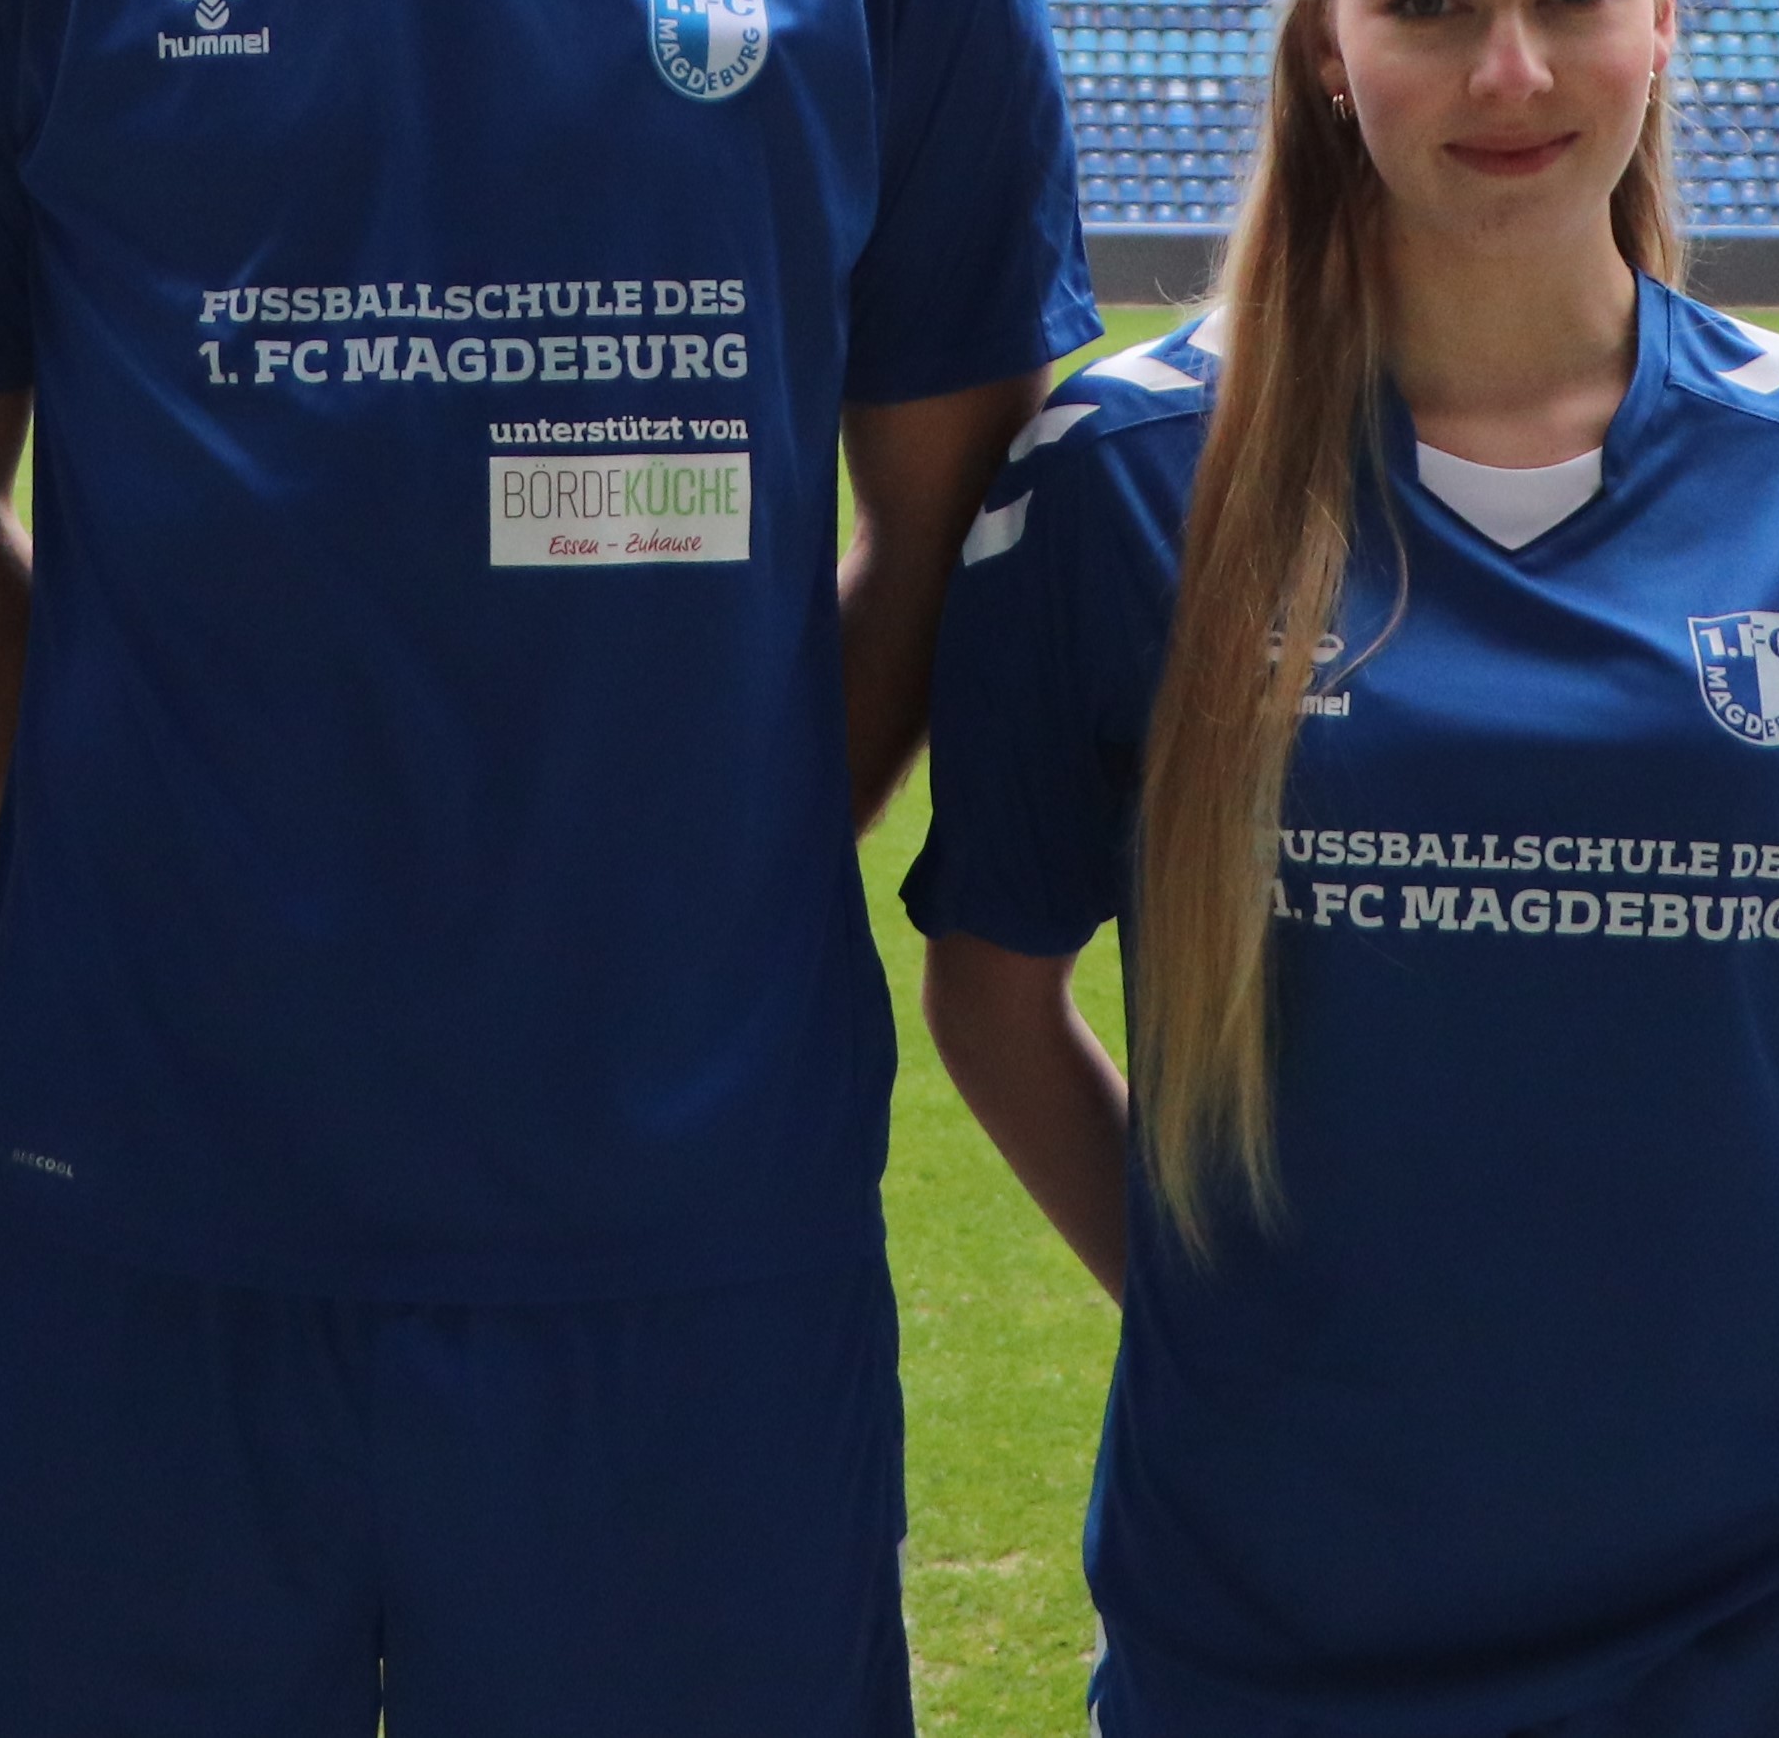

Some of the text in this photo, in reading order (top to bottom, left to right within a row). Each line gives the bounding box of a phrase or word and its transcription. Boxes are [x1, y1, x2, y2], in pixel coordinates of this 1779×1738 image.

[157, 26, 270, 59] hummel
[658, 17, 761, 92] MAGDEBURG
[198, 278, 747, 325] FUSSBALLSCHULE DES
[197, 332, 749, 385] 1. FC MAGDEBURG
[488, 415, 750, 444] unterstützt von
[502, 463, 740, 521] BÖRDEKÜCHE
[548, 532, 600, 556] Essen
[625, 531, 702, 555] Zuhause
[1279, 828, 1721, 878] USSBALLSCHULE
[1311, 881, 1386, 929] FC
